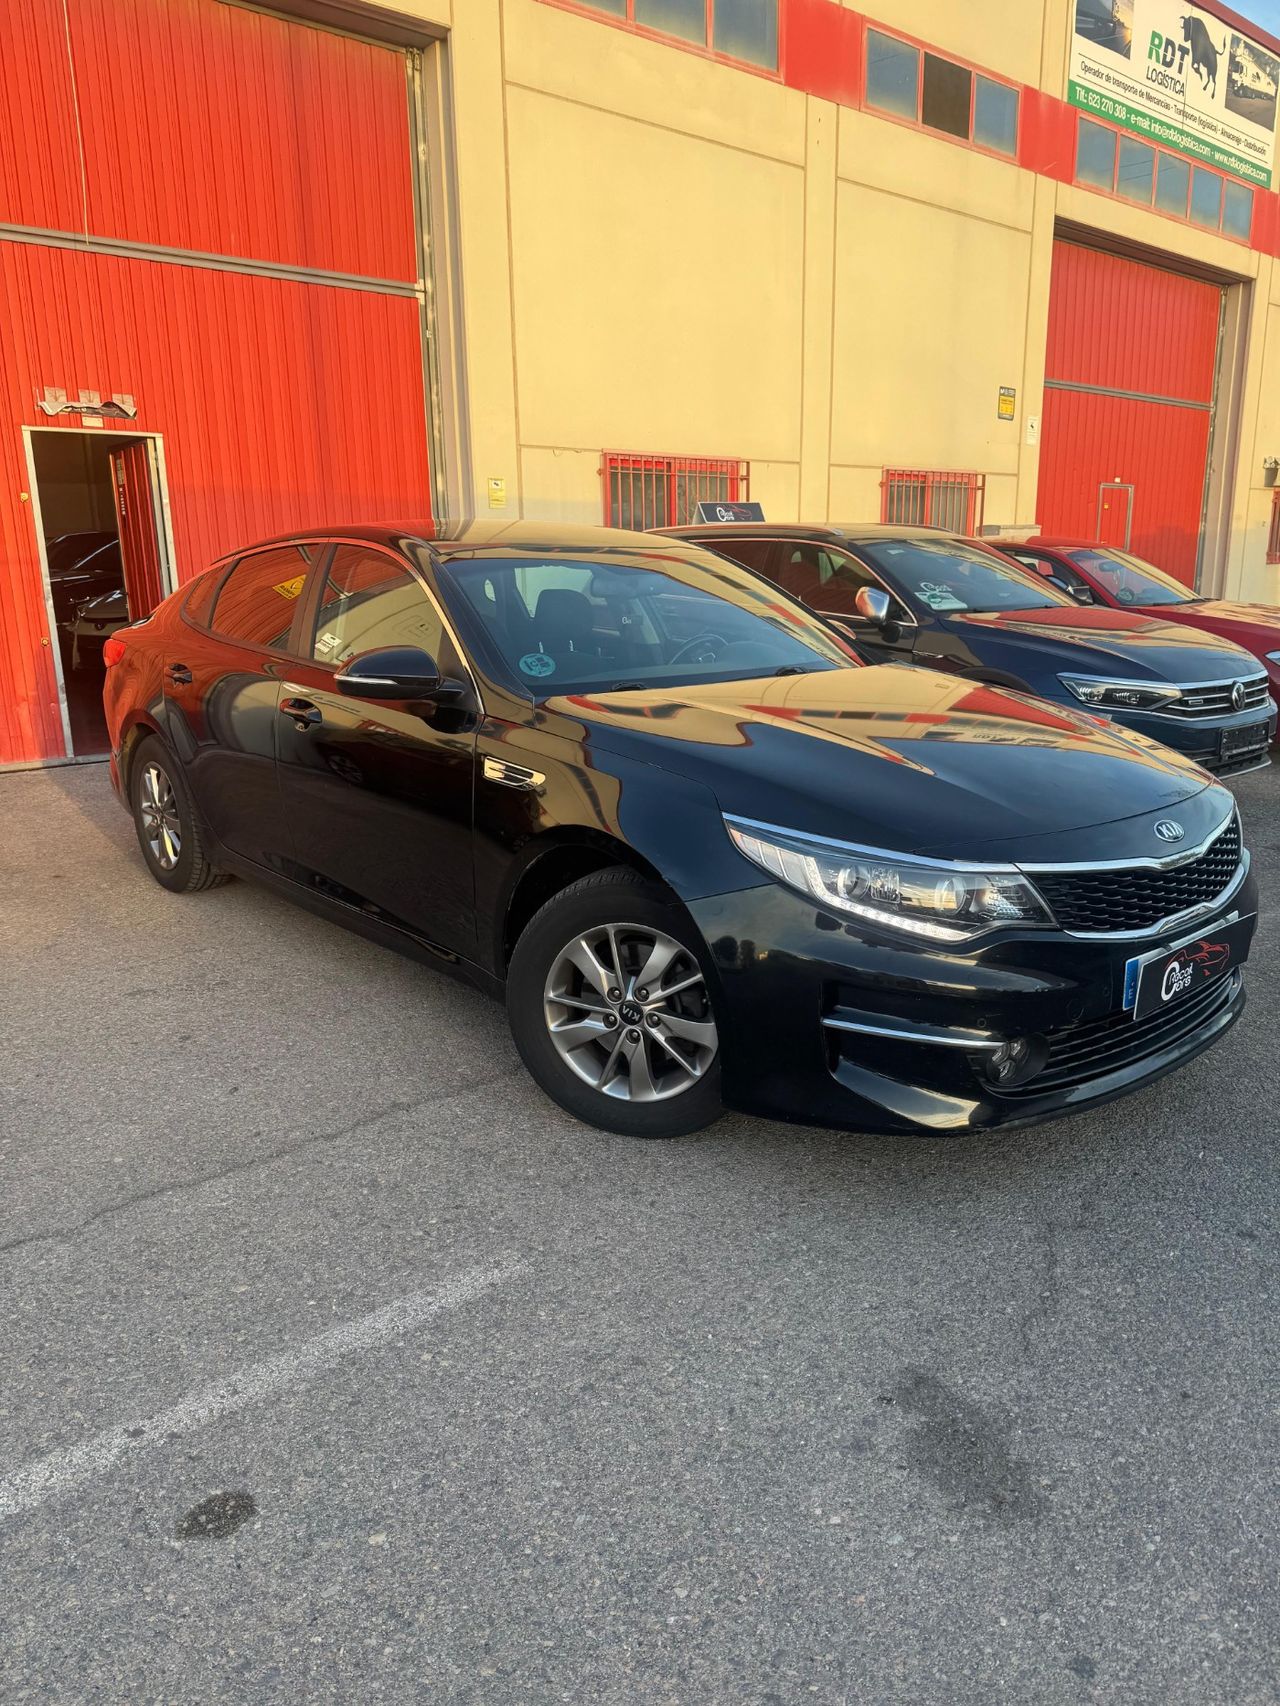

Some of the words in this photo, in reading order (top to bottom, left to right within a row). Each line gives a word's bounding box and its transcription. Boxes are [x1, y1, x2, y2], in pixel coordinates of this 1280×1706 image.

[1148, 30, 1190, 75] RDT
[1081, 60, 1104, 80] Operador
[1105, 73, 1111, 84] de
[1112, 76, 1138, 96] transporte
[1139, 89, 1145, 99] de
[1146, 65, 1185, 97] LOGÍSTICA
[1088, 92, 1100, 109] 623
[1101, 98, 1114, 114] 270
[1114, 103, 1126, 120] 308
[1158, 822, 1183, 838] KIA
[622, 1005, 640, 1021] KIA
